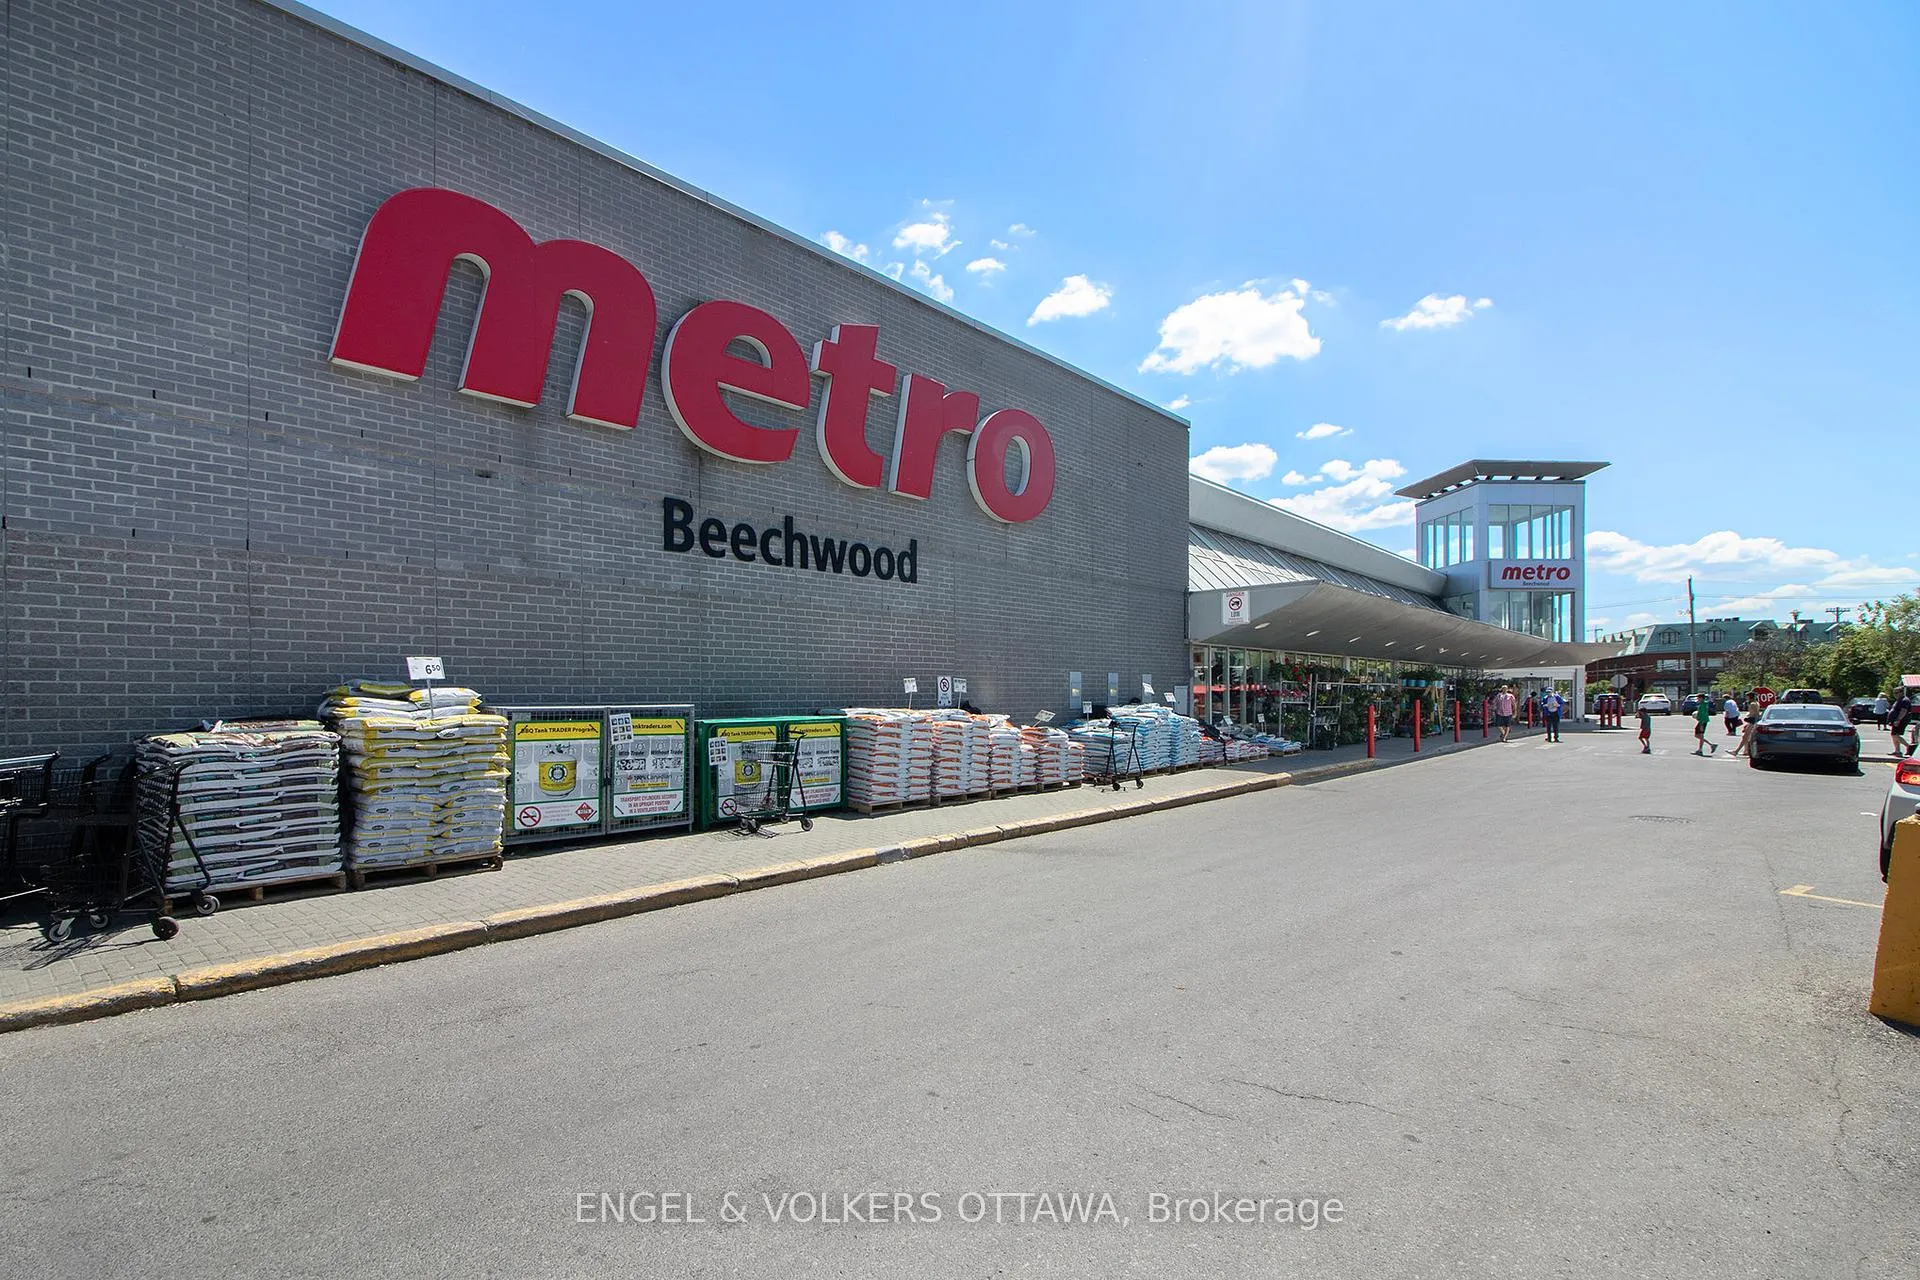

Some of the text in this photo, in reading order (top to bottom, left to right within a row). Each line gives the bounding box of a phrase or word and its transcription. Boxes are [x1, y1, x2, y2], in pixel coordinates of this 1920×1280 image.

[328, 187, 1056, 524] metro
[663, 496, 918, 584] Beechwood
[1501, 564, 1571, 581] metro
